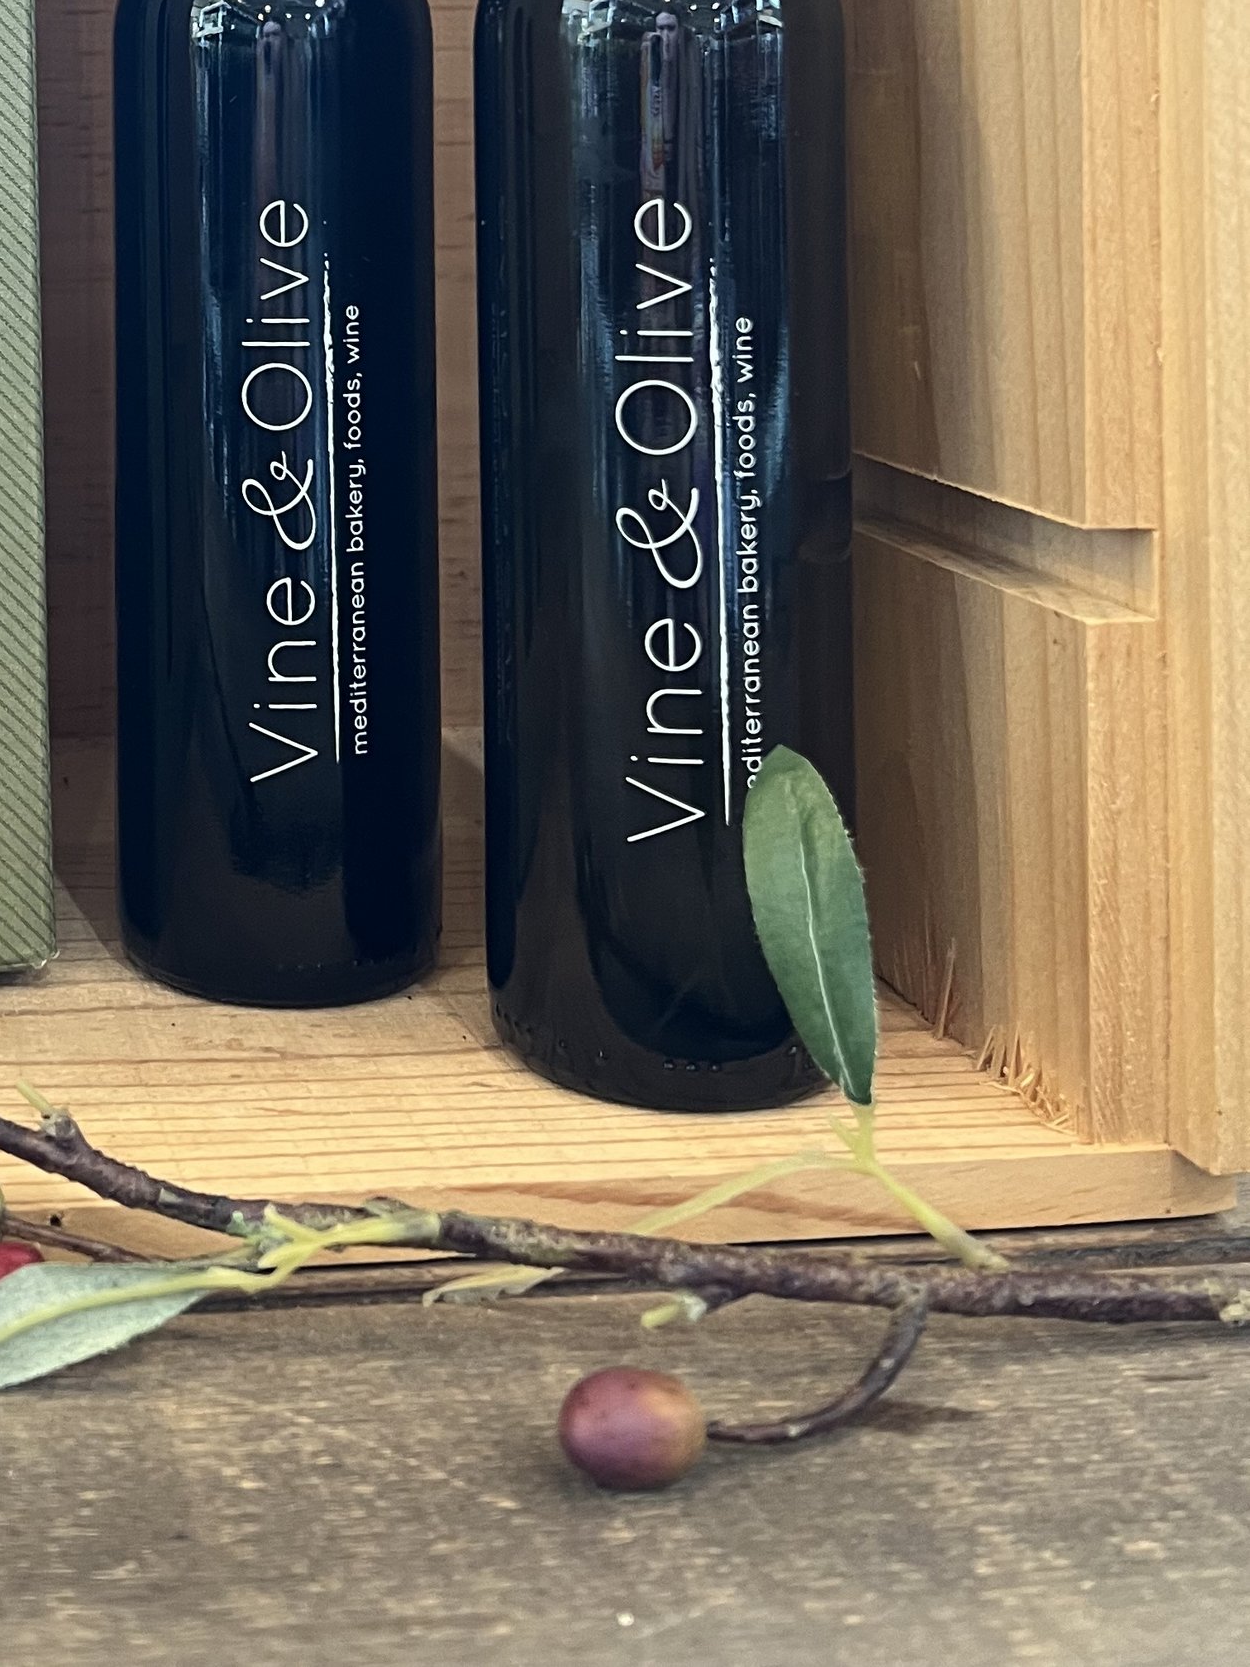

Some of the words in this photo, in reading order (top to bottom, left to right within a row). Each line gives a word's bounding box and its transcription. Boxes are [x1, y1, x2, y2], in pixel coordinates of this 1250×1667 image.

[241, 200, 313, 431] Olive
[345, 305, 360, 364] wine
[614, 198, 698, 456] Olive
[735, 317, 754, 383] wine
[342, 372, 363, 450] foods,
[732, 392, 757, 479] foods,
[241, 450, 316, 551] &
[345, 458, 366, 552] bakery,
[615, 478, 702, 589] &
[735, 488, 761, 593] bakery,
[249, 577, 319, 783] Vine
[349, 562, 368, 755] mediterranean
[740, 604, 763, 789] diterranean
[625, 618, 706, 842] Vine
